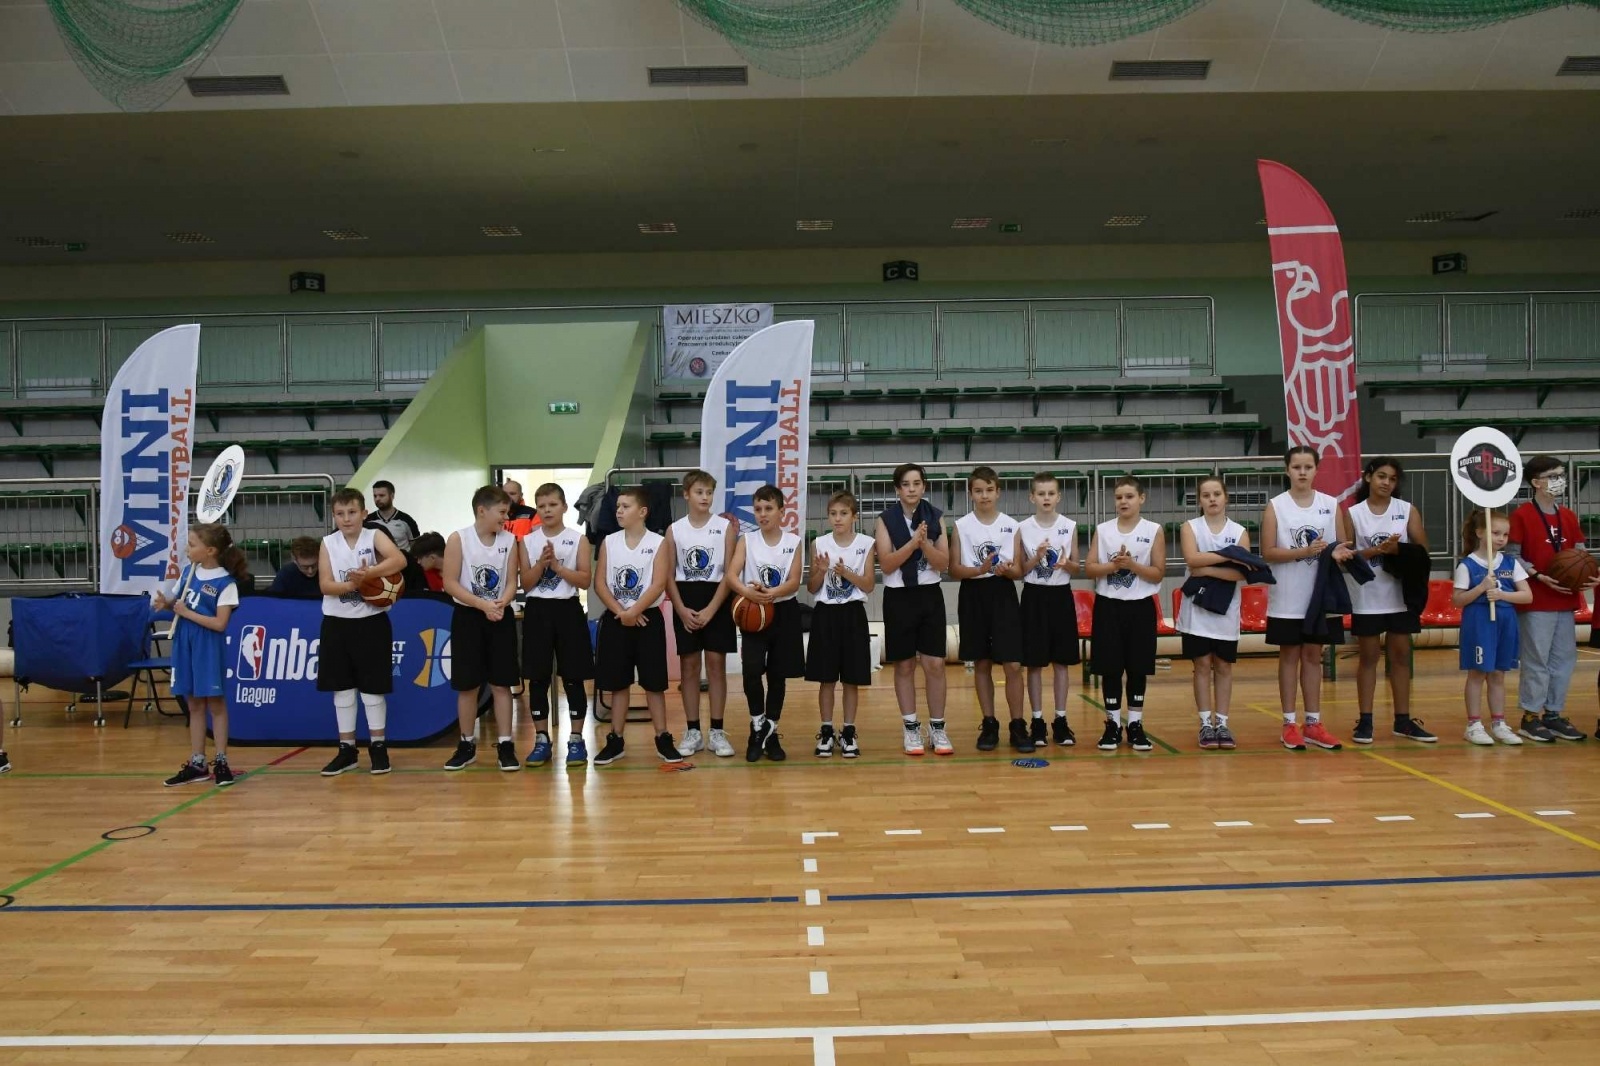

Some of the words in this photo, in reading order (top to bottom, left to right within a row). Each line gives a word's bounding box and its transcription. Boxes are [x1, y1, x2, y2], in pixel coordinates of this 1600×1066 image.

[1438, 260, 1455, 271] D
[886, 267, 898, 278] C
[905, 267, 916, 278] C
[305, 278, 319, 290] B
[676, 308, 760, 325] MIESZKO
[121, 388, 169, 581] MINI
[235, 682, 276, 708] League
